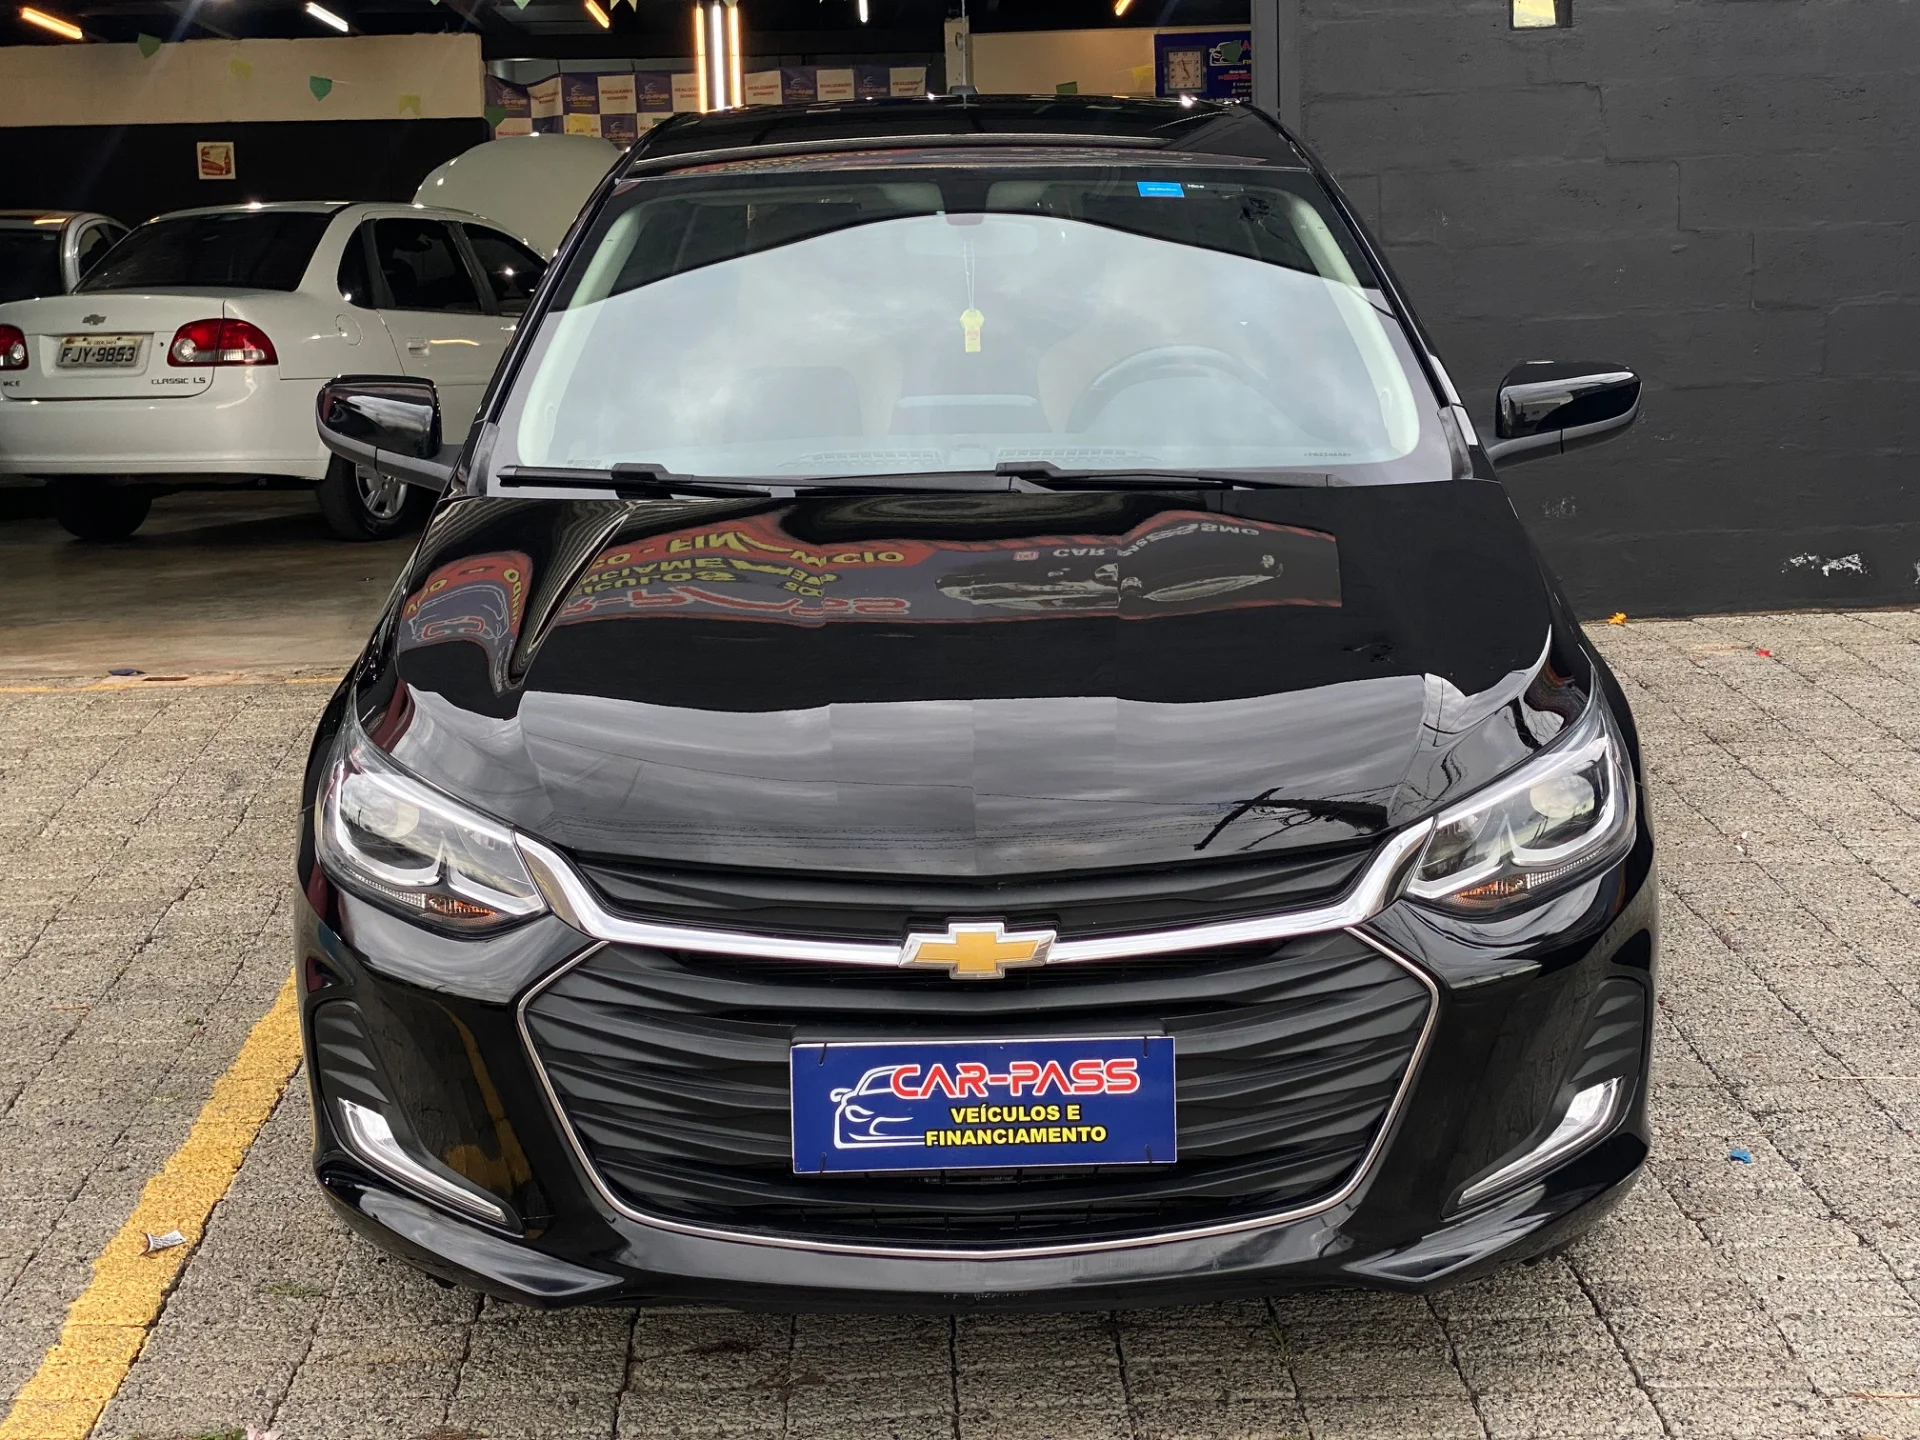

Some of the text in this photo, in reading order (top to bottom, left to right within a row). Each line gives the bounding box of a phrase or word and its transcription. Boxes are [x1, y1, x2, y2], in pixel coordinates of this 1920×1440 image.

[889, 1058, 1141, 1099] CAR-PASS
[950, 1104, 1081, 1124] VEÍCULOS E
[925, 1126, 1107, 1147] FINANCIAMENTO
